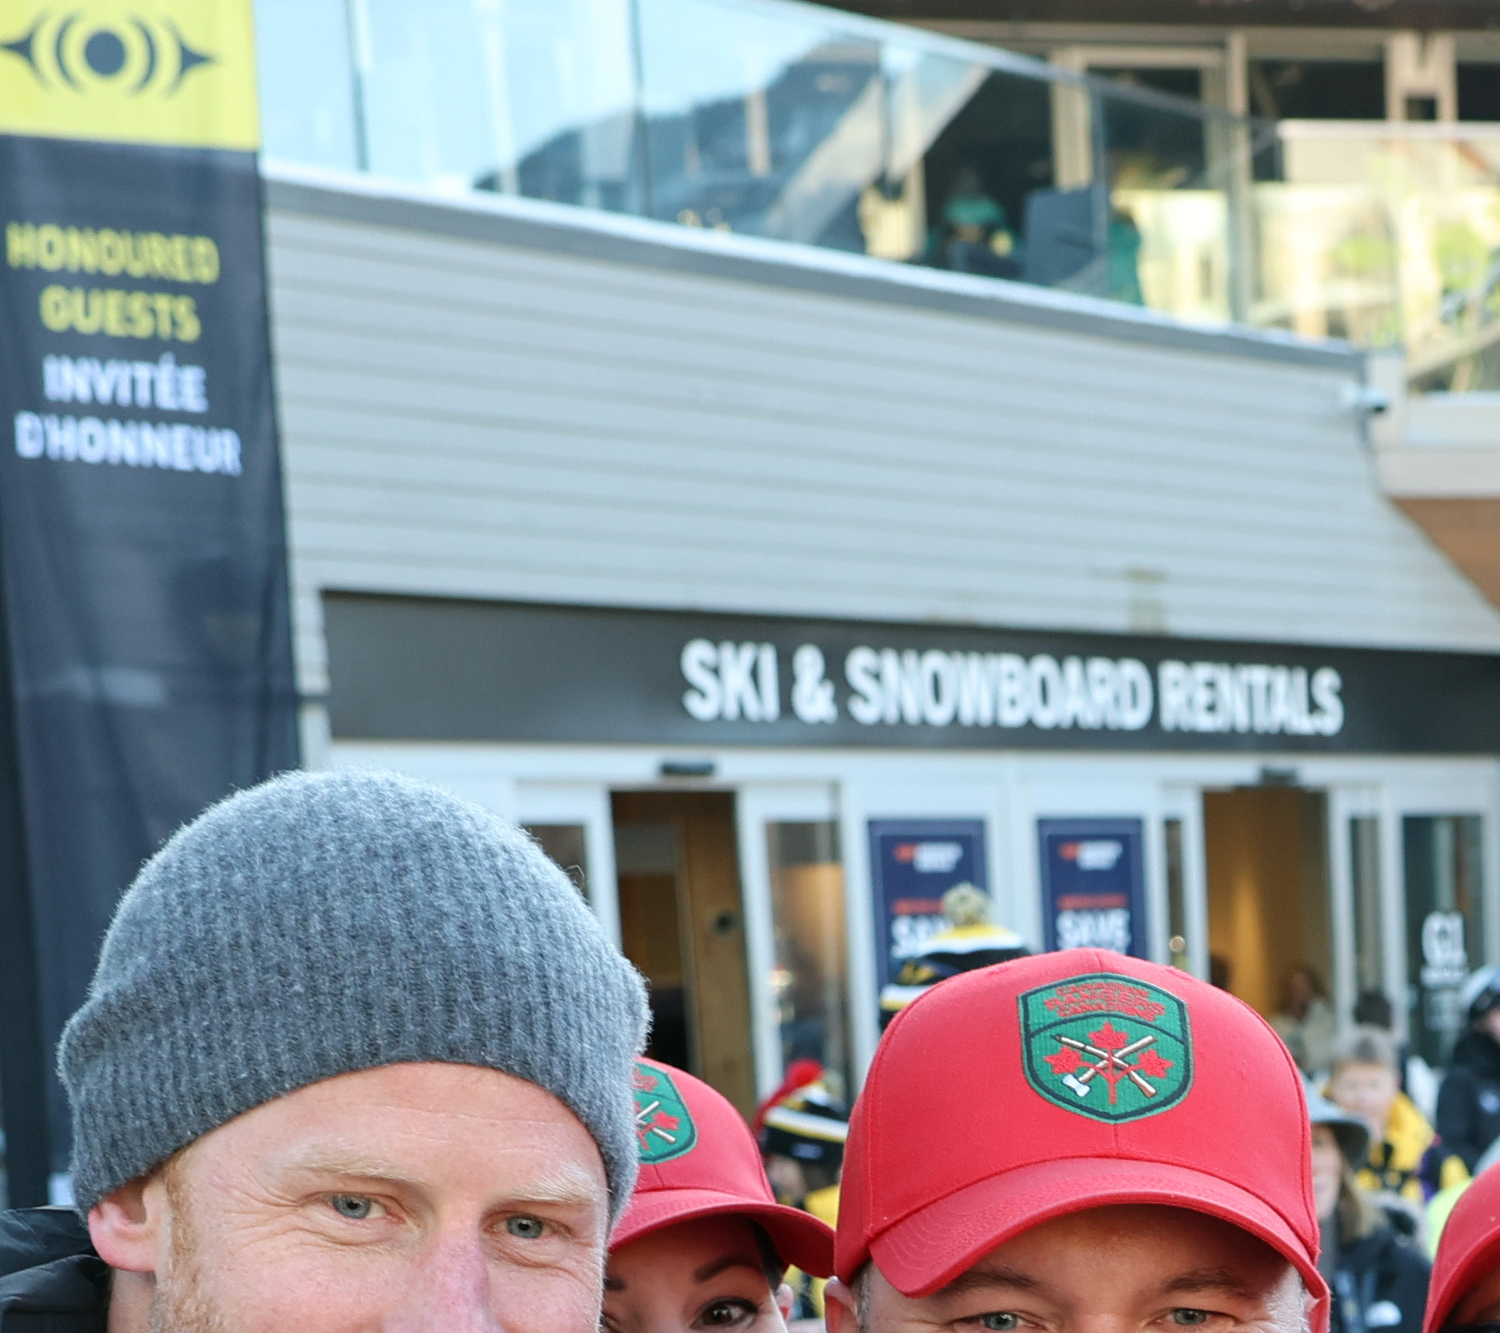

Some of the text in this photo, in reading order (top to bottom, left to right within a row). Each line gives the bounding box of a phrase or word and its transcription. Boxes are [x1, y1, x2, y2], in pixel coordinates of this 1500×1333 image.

[7, 222, 220, 284] HONOURED
[40, 284, 200, 342] GUESTS
[15, 412, 242, 476] D'HONNEUR
[680, 637, 1344, 737] SKI & SNOWBOARD RENTALS
